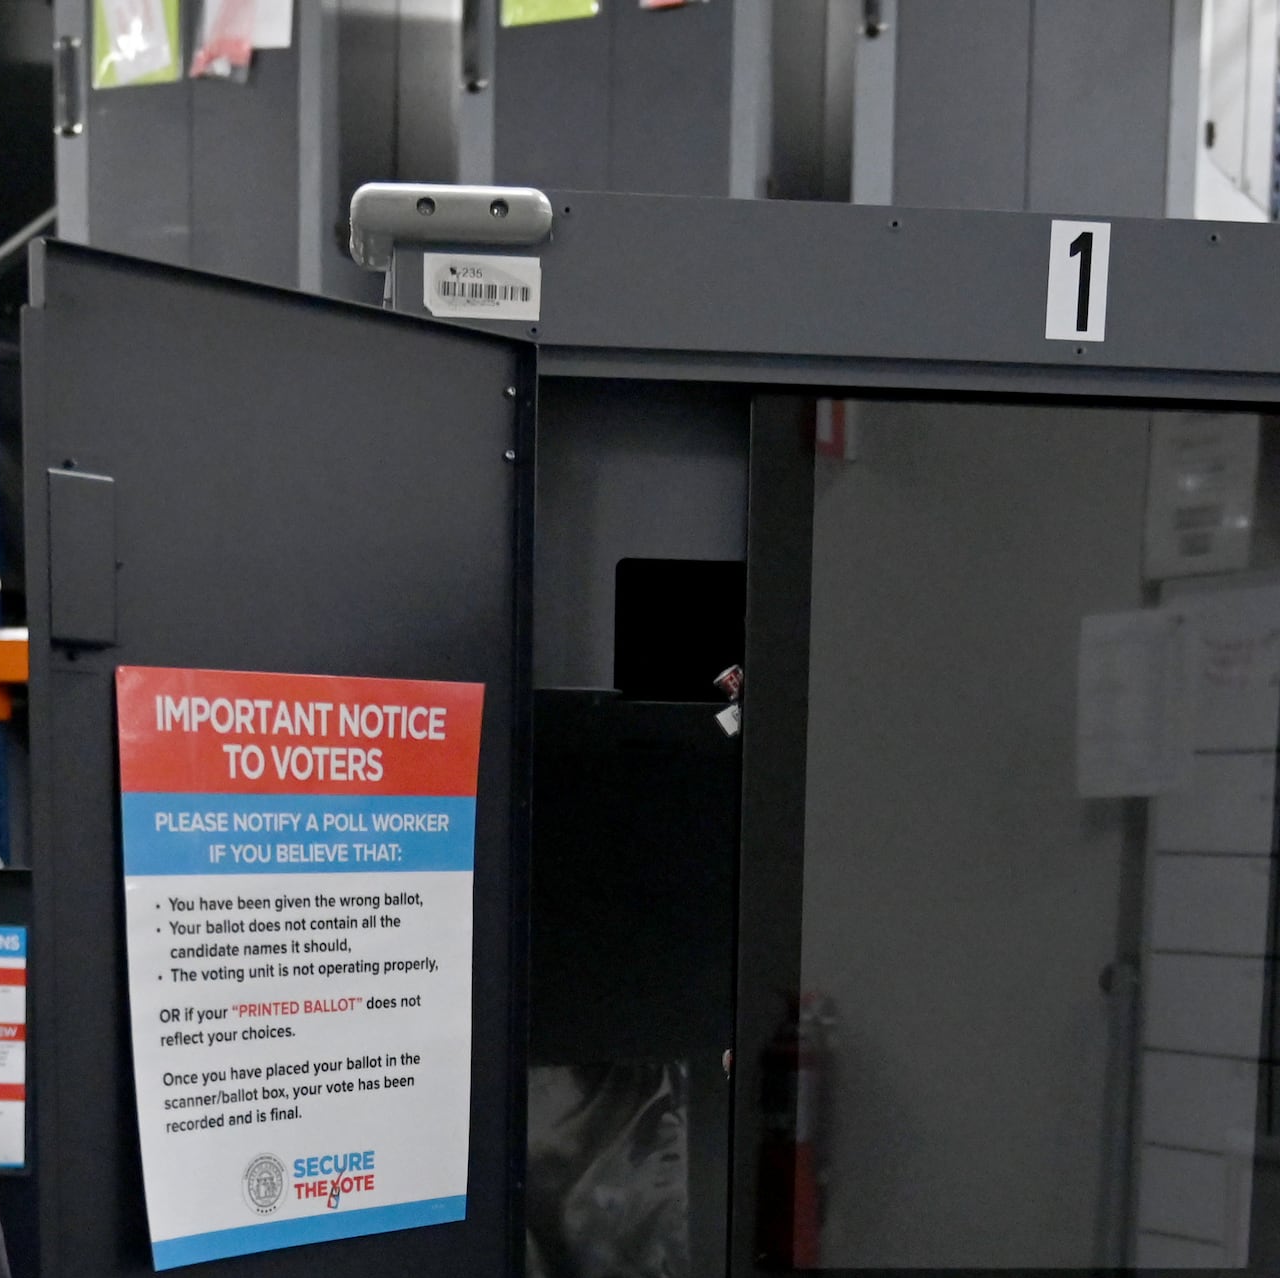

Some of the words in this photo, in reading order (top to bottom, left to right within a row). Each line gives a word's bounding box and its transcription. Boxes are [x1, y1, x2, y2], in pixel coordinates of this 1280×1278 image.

[1069, 231, 1094, 332] 1
[155, 694, 333, 736] IMPORTANT
[339, 703, 447, 740] NOTICE
[222, 743, 265, 780] TO
[270, 745, 383, 781] VOTERS
[155, 811, 229, 832] PLEASE
[233, 812, 302, 832] NOTIFY
[305, 813, 319, 831] A
[323, 812, 368, 832] POLL
[371, 813, 449, 832] WORKER
[209, 844, 226, 863] IF
[230, 843, 271, 863] YOU
[276, 843, 348, 863] BELIEVE
[352, 843, 402, 861] THAT:
[168, 897, 194, 911] You
[199, 897, 233, 911] have
[237, 895, 271, 910] been
[274, 894, 311, 912] given
[314, 894, 336, 908] the
[339, 895, 380, 910] wrong
[168, 920, 201, 935] Your
[205, 919, 245, 934] ballot
[248, 918, 281, 933] does
[284, 918, 306, 931] not
[309, 915, 358, 930] contain
[361, 914, 376, 928] all
[379, 914, 401, 928] the
[170, 943, 239, 959] candidate
[243, 943, 287, 956] names
[291, 939, 300, 953] it
[170, 968, 197, 982] The
[201, 966, 244, 983] voting
[248, 963, 274, 978] unit
[278, 963, 289, 977] is
[293, 962, 314, 976] not
[318, 959, 380, 978] operating
[159, 1008, 180, 1023] OR
[184, 1007, 194, 1021] if
[196, 1008, 228, 1024] your
[366, 996, 397, 1010] does
[400, 994, 421, 1007] not
[160, 1031, 204, 1047] reflect
[207, 1030, 238, 1047] your
[162, 1072, 198, 1086] Once
[201, 1070, 226, 1086] you
[230, 1067, 262, 1080] have
[266, 1060, 309, 1080] placed
[313, 1060, 343, 1076] your
[346, 1055, 382, 1070] ballot
[385, 1053, 397, 1067] in
[400, 1052, 420, 1066] the
[164, 1088, 258, 1110] scanner/ballot
[292, 1084, 322, 1100] your
[325, 1080, 354, 1094] vote
[358, 1077, 380, 1091] has
[383, 1075, 414, 1088] been
[166, 1113, 224, 1133] recorded
[228, 1110, 252, 1126] and
[256, 1109, 267, 1123] is
[293, 1150, 375, 1178] SECURE
[294, 1180, 328, 1200] THE
